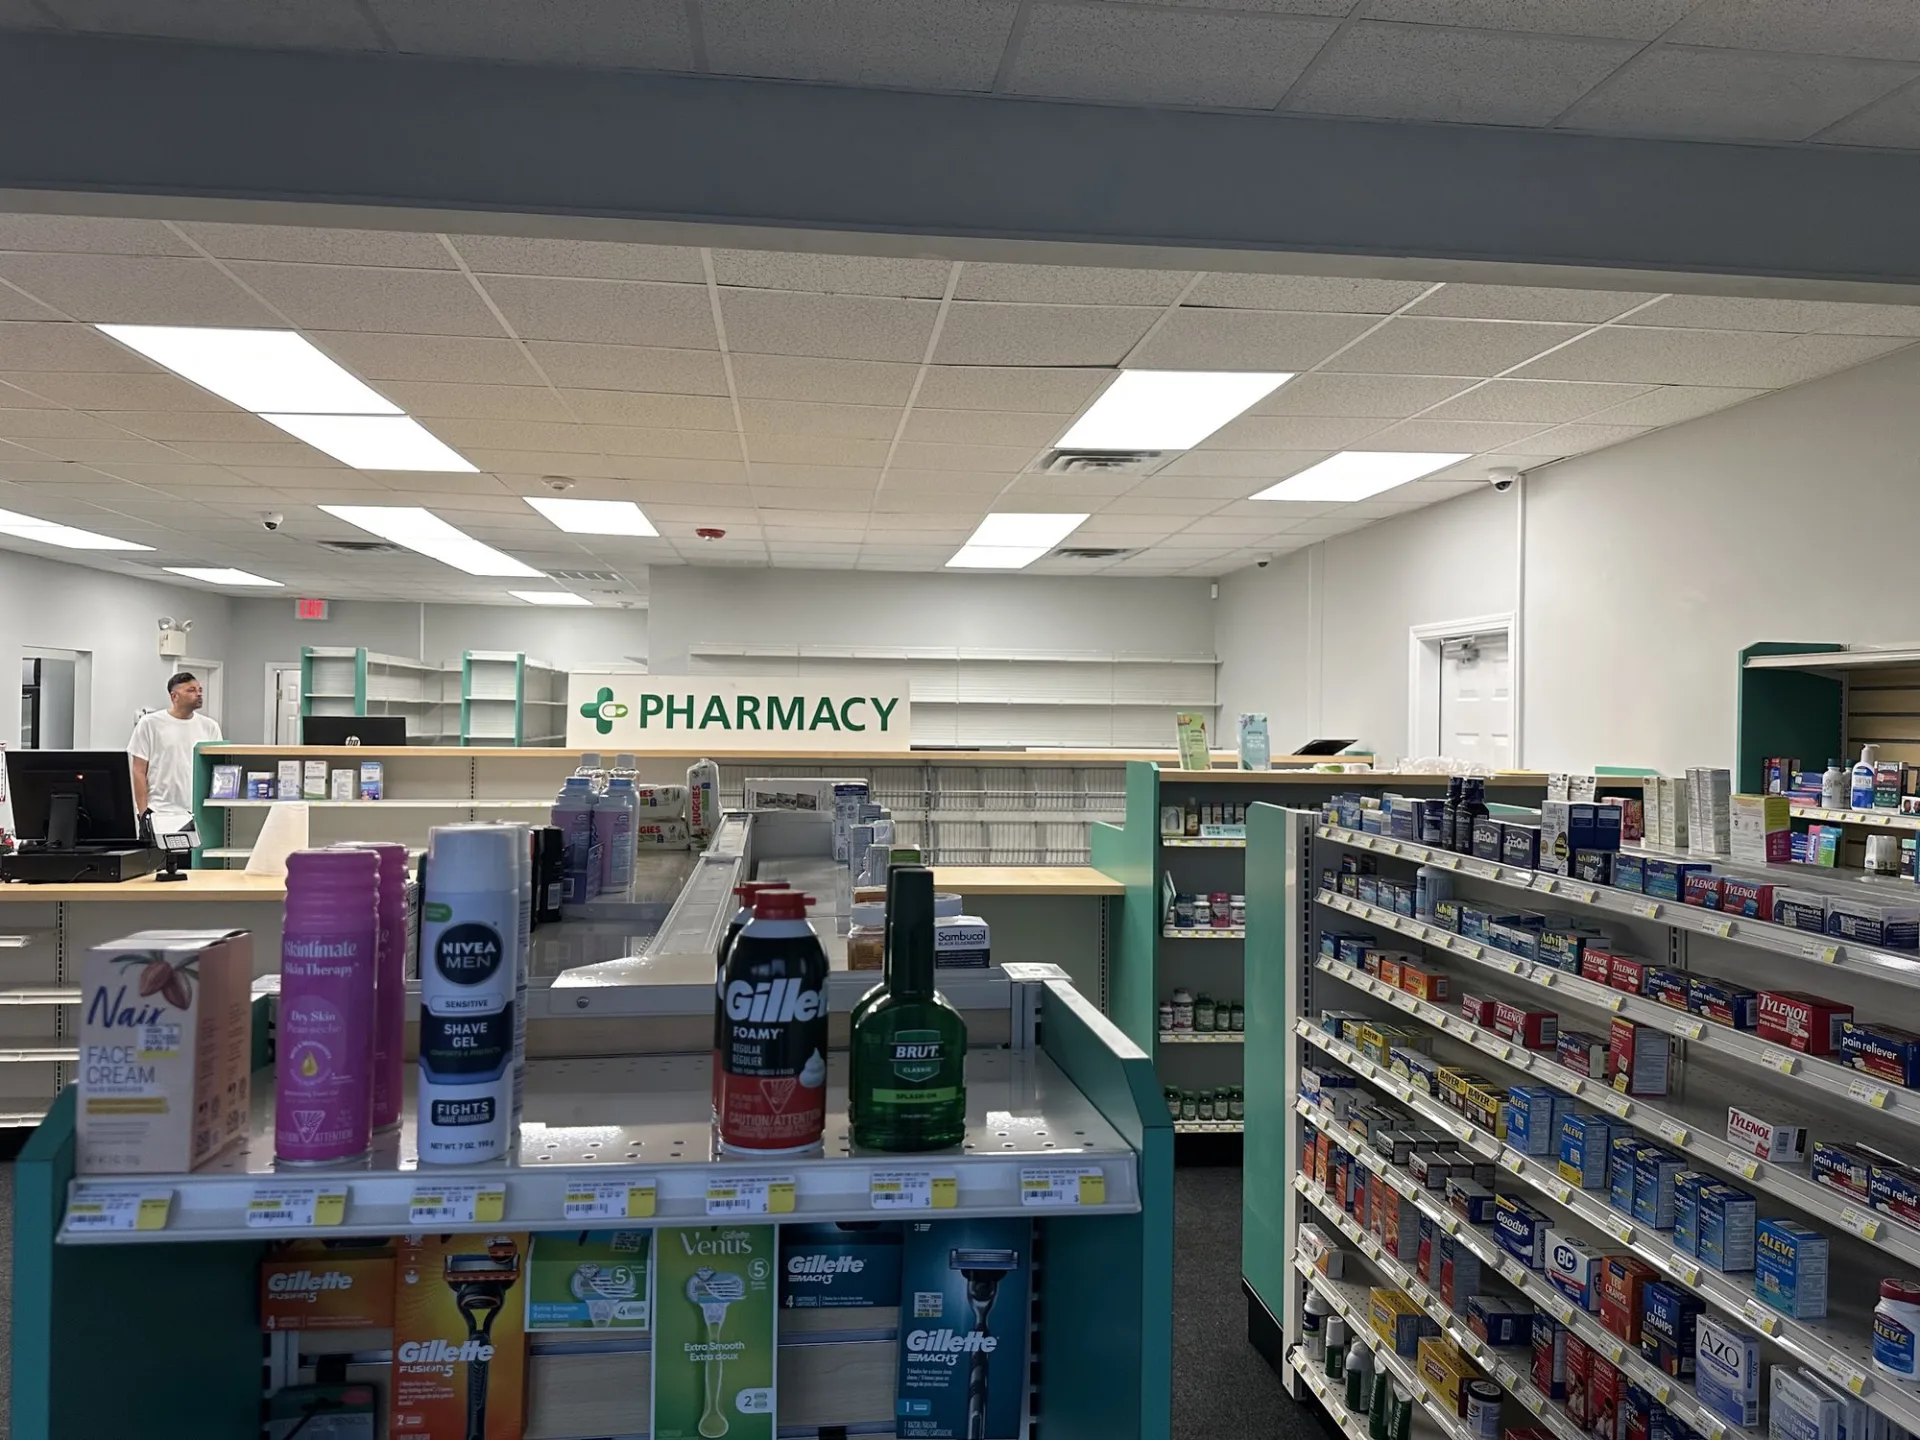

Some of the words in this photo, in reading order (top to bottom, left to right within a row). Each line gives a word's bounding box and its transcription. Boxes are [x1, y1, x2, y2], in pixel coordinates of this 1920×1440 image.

[300, 599, 323, 617] EXIT
[639, 693, 899, 732] PHARMACY
[692, 785, 701, 826] HUGGIES
[639, 825, 661, 834] GIES
[1686, 876, 1718, 891] TYLENOL
[1725, 882, 1758, 899] TYLENOL
[938, 929, 986, 942] Sambucol
[1541, 932, 1562, 947] Advil
[284, 940, 357, 958] Skintimate
[442, 941, 497, 955] NIVEA
[446, 955, 491, 969] MEN
[1584, 952, 1608, 968] TYLENOL
[1612, 960, 1638, 976] TYLENOL
[285, 962, 304, 975] Skin
[306, 963, 353, 978] Therapy
[445, 1000, 488, 1008] SENSITIVE
[1690, 989, 1703, 999] pain
[1703, 993, 1726, 1006] reliever
[87, 985, 166, 1029] Nair
[1495, 1004, 1525, 1026] TYLENOL
[1759, 993, 1809, 1023] TYLENOL
[291, 1010, 308, 1024] Dry
[311, 1010, 336, 1022] Skin
[443, 1022, 488, 1035] SHAVE
[733, 1026, 780, 1040] FOAMY
[452, 1036, 479, 1048] GEL
[1842, 1036, 1862, 1050] pain
[1862, 1042, 1898, 1061] reliever
[87, 1046, 135, 1065] FACE
[895, 1045, 939, 1058] BRUT
[86, 1066, 156, 1085] CREAM
[1440, 1070, 1460, 1088] BAYER
[1467, 1087, 1490, 1107] BAYER
[1510, 1095, 1529, 1111] ALEVE
[437, 1101, 489, 1115] FIGHTS
[1562, 1122, 1584, 1140] ALEVE
[1729, 1110, 1770, 1141] TYLENOL
[1813, 1154, 1832, 1168] pain
[1832, 1161, 1852, 1177] relie
[1871, 1179, 1891, 1195] pain
[1892, 1186, 1918, 1207] relief
[1496, 1210, 1530, 1236] Goody's
[680, 1231, 753, 1256] Venus
[1758, 1231, 1795, 1260] ALEVE
[787, 1254, 865, 1274] Gillette
[1557, 1247, 1574, 1269] BC
[1757, 1245, 1777, 1259] LIQUID
[1777, 1254, 1793, 1267] GELS
[615, 1268, 627, 1285] 5
[754, 1260, 765, 1278] 5
[267, 1270, 354, 1292] Gillette
[794, 1274, 834, 1285] MACH3
[1611, 1277, 1622, 1289] LEG
[785, 1295, 794, 1308] 4
[1605, 1283, 1627, 1305] CRAMPS
[1653, 1303, 1667, 1318] LEG
[266, 1315, 276, 1330] 4
[1646, 1311, 1673, 1336] CRAMPS
[906, 1329, 998, 1353] Gillette
[1874, 1320, 1908, 1345] ALEVE
[397, 1339, 496, 1363] Gillette
[684, 1342, 707, 1351] Extra
[708, 1341, 745, 1352] Smooth
[1700, 1330, 1740, 1368] AZO
[690, 1352, 714, 1361] Extra
[714, 1352, 739, 1361] doux
[915, 1354, 959, 1366] MACH3
[744, 1395, 752, 1407] 2
[905, 1401, 910, 1413] 1
[396, 1414, 404, 1427] 2
